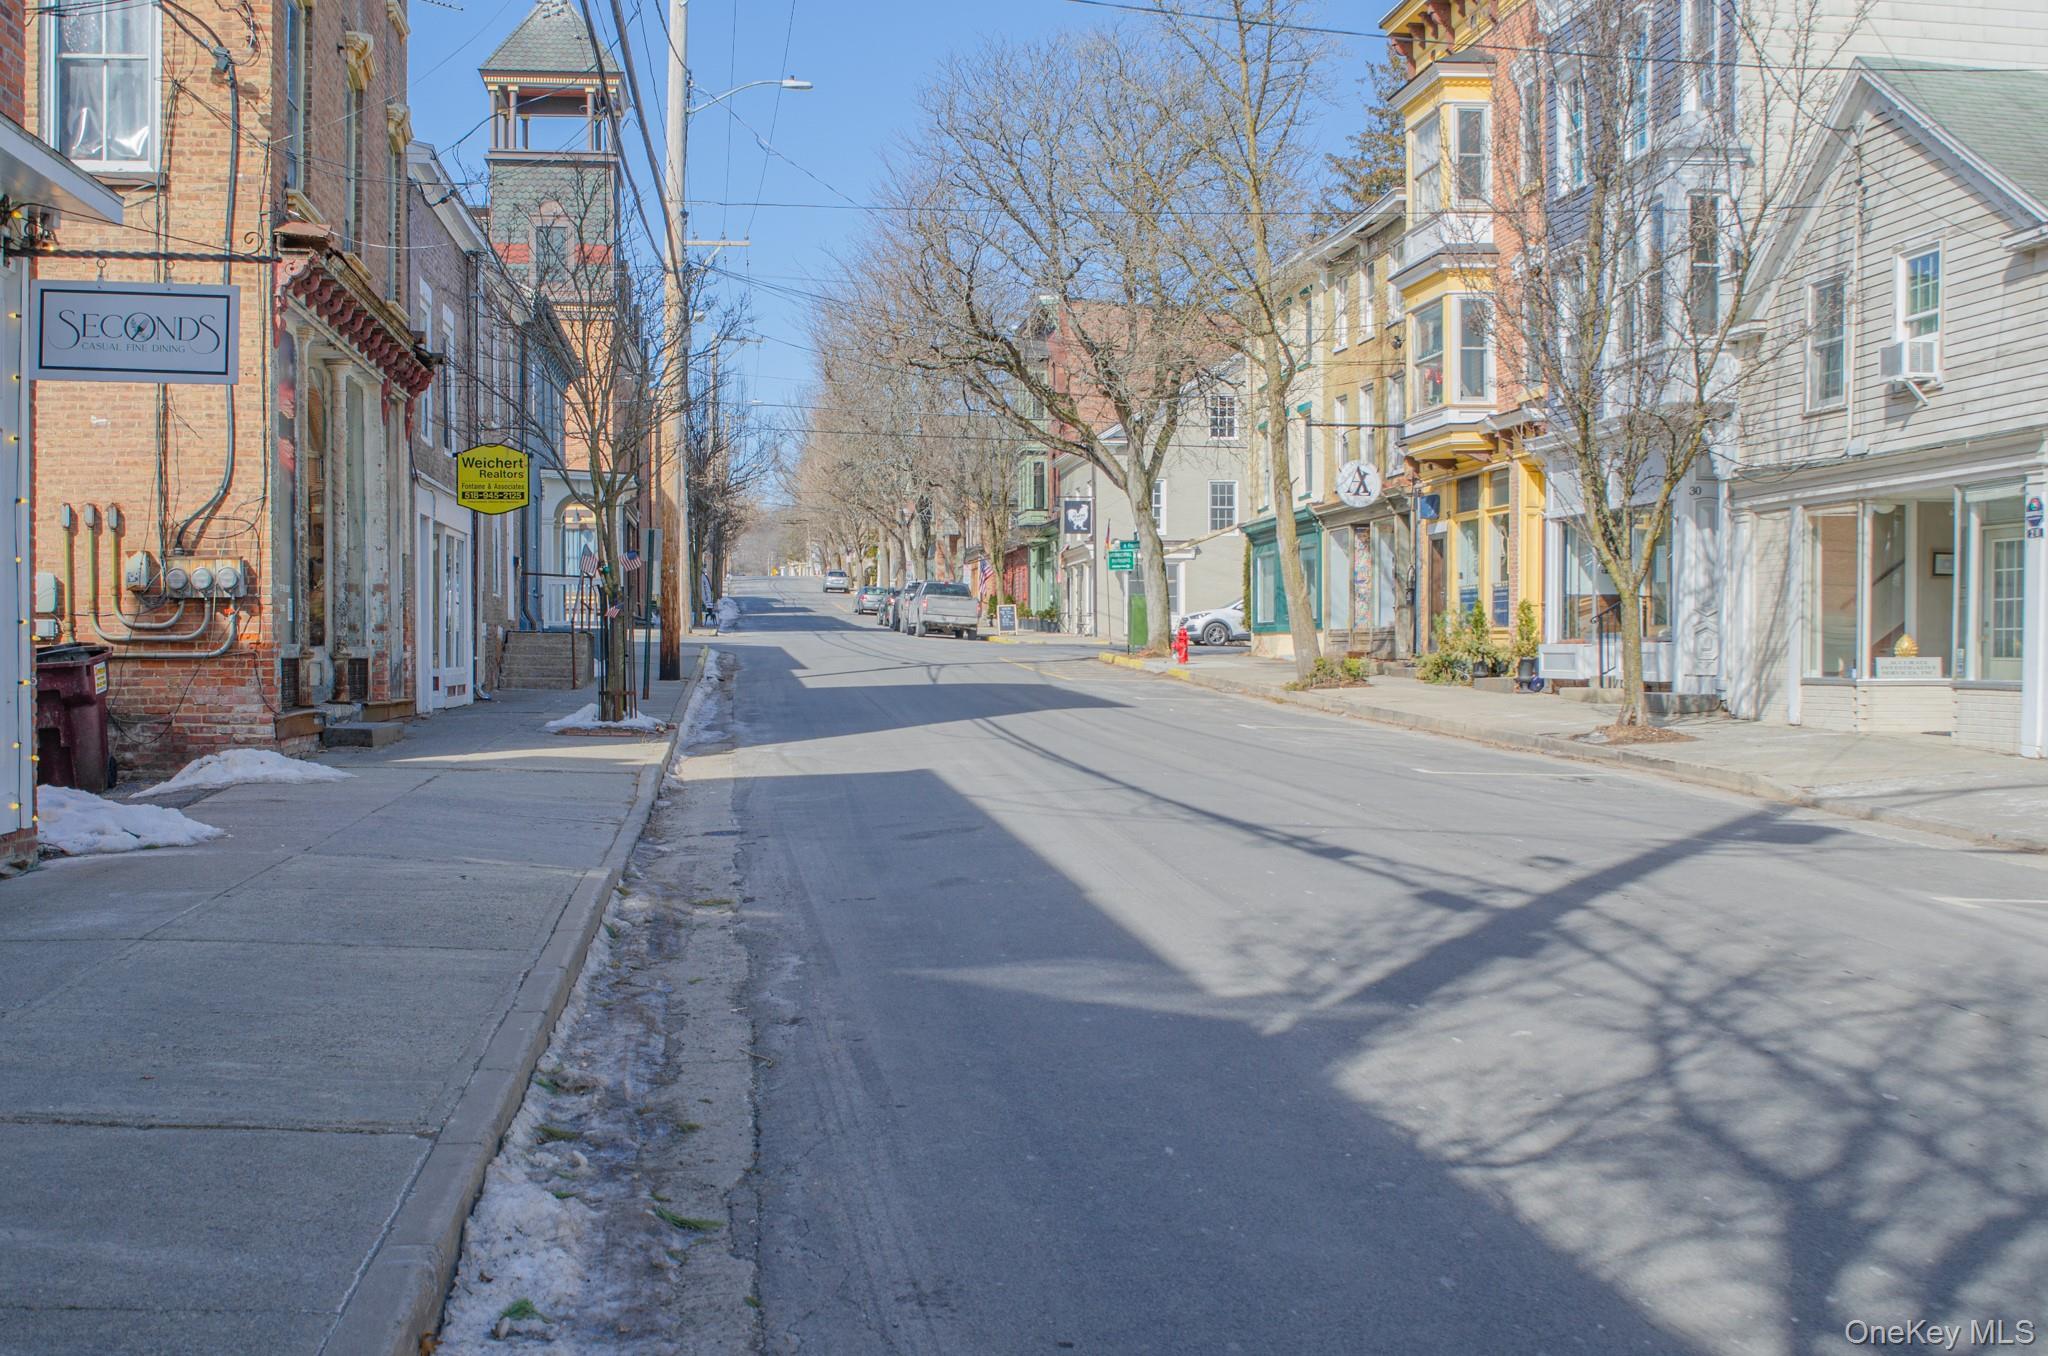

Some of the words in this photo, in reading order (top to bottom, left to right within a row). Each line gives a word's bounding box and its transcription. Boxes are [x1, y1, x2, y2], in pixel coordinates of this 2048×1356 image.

[48, 309, 221, 354] SECONDS
[82, 342, 121, 351] CASUAL
[126, 343, 146, 352] FINE
[152, 344, 186, 353] DINING
[462, 457, 524, 469] Weichert
[479, 469, 524, 479] Realtors
[1689, 486, 1702, 496] 30
